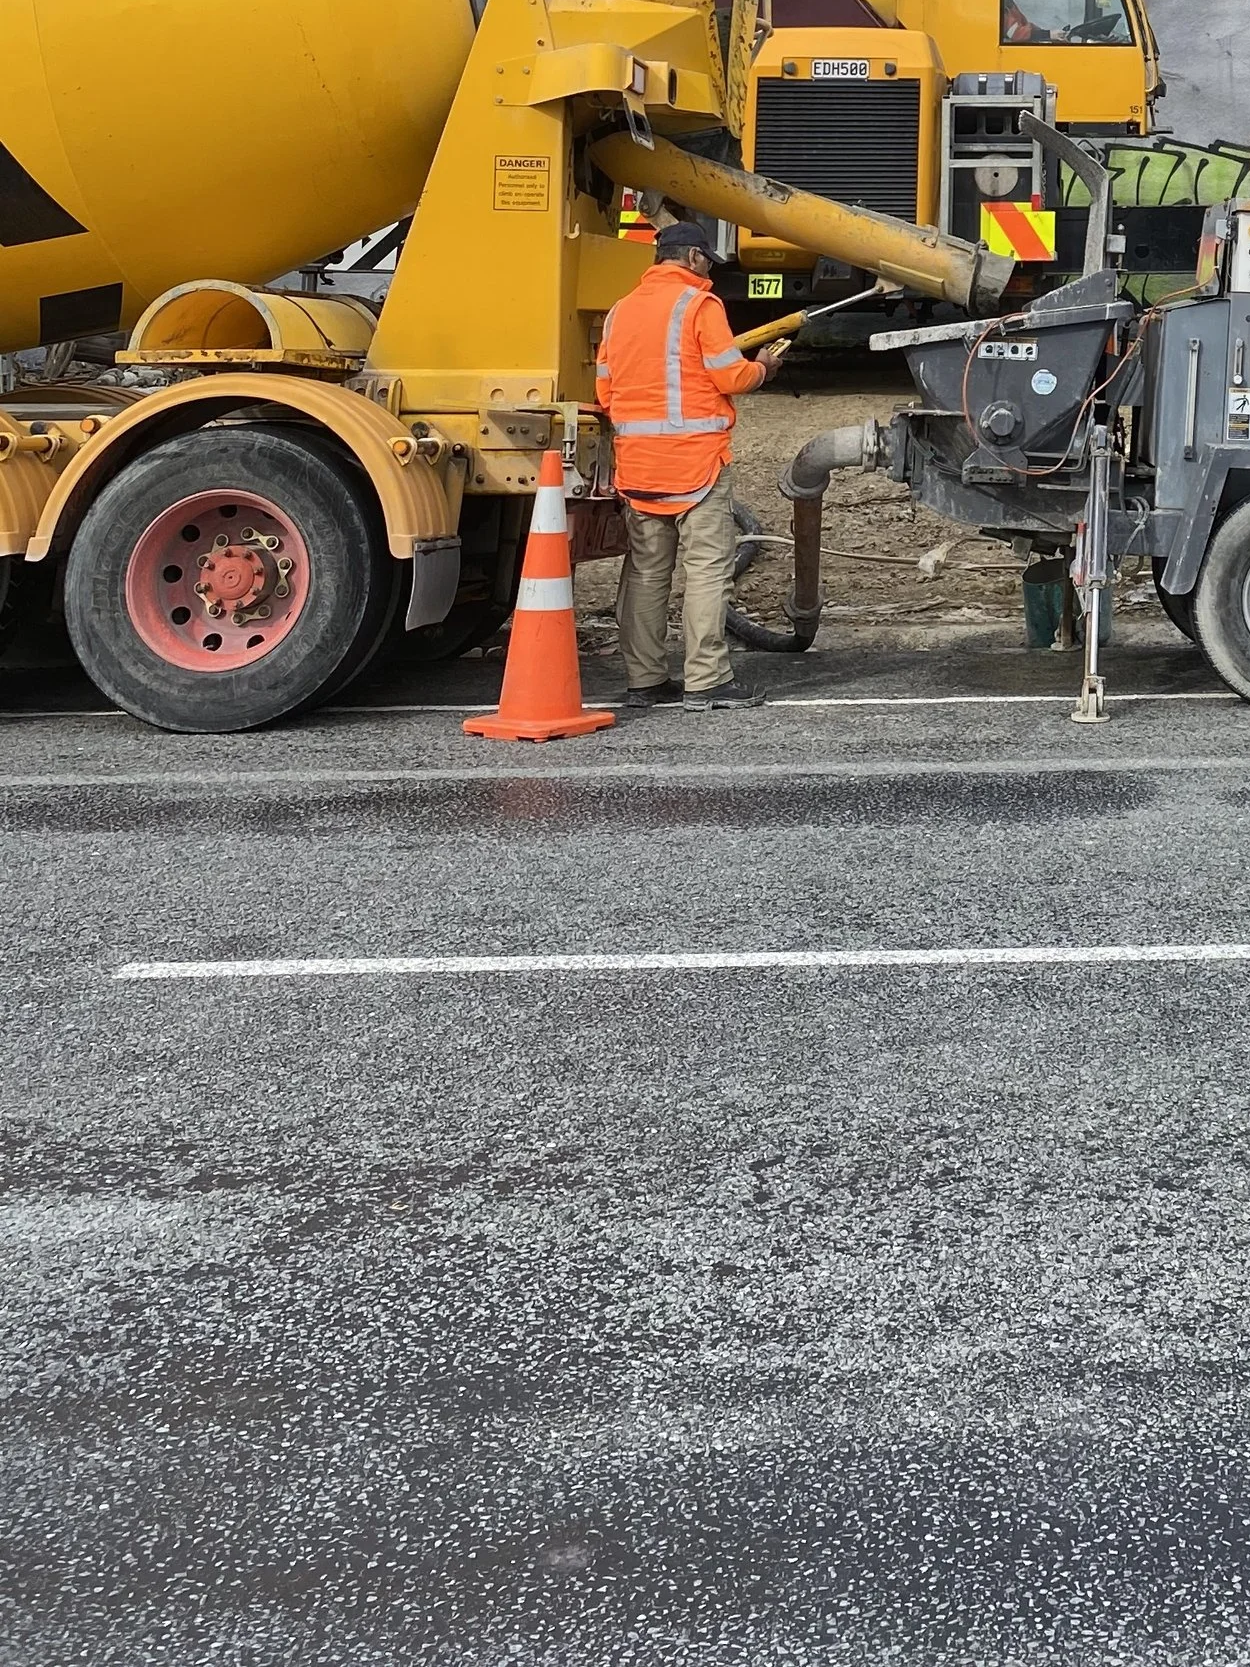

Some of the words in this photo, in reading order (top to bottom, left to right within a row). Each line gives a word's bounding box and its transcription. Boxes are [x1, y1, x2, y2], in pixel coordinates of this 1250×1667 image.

[813, 62, 867, 76] EDH500
[499, 159, 545, 168] DANGER!
[750, 278, 781, 295] 1577
